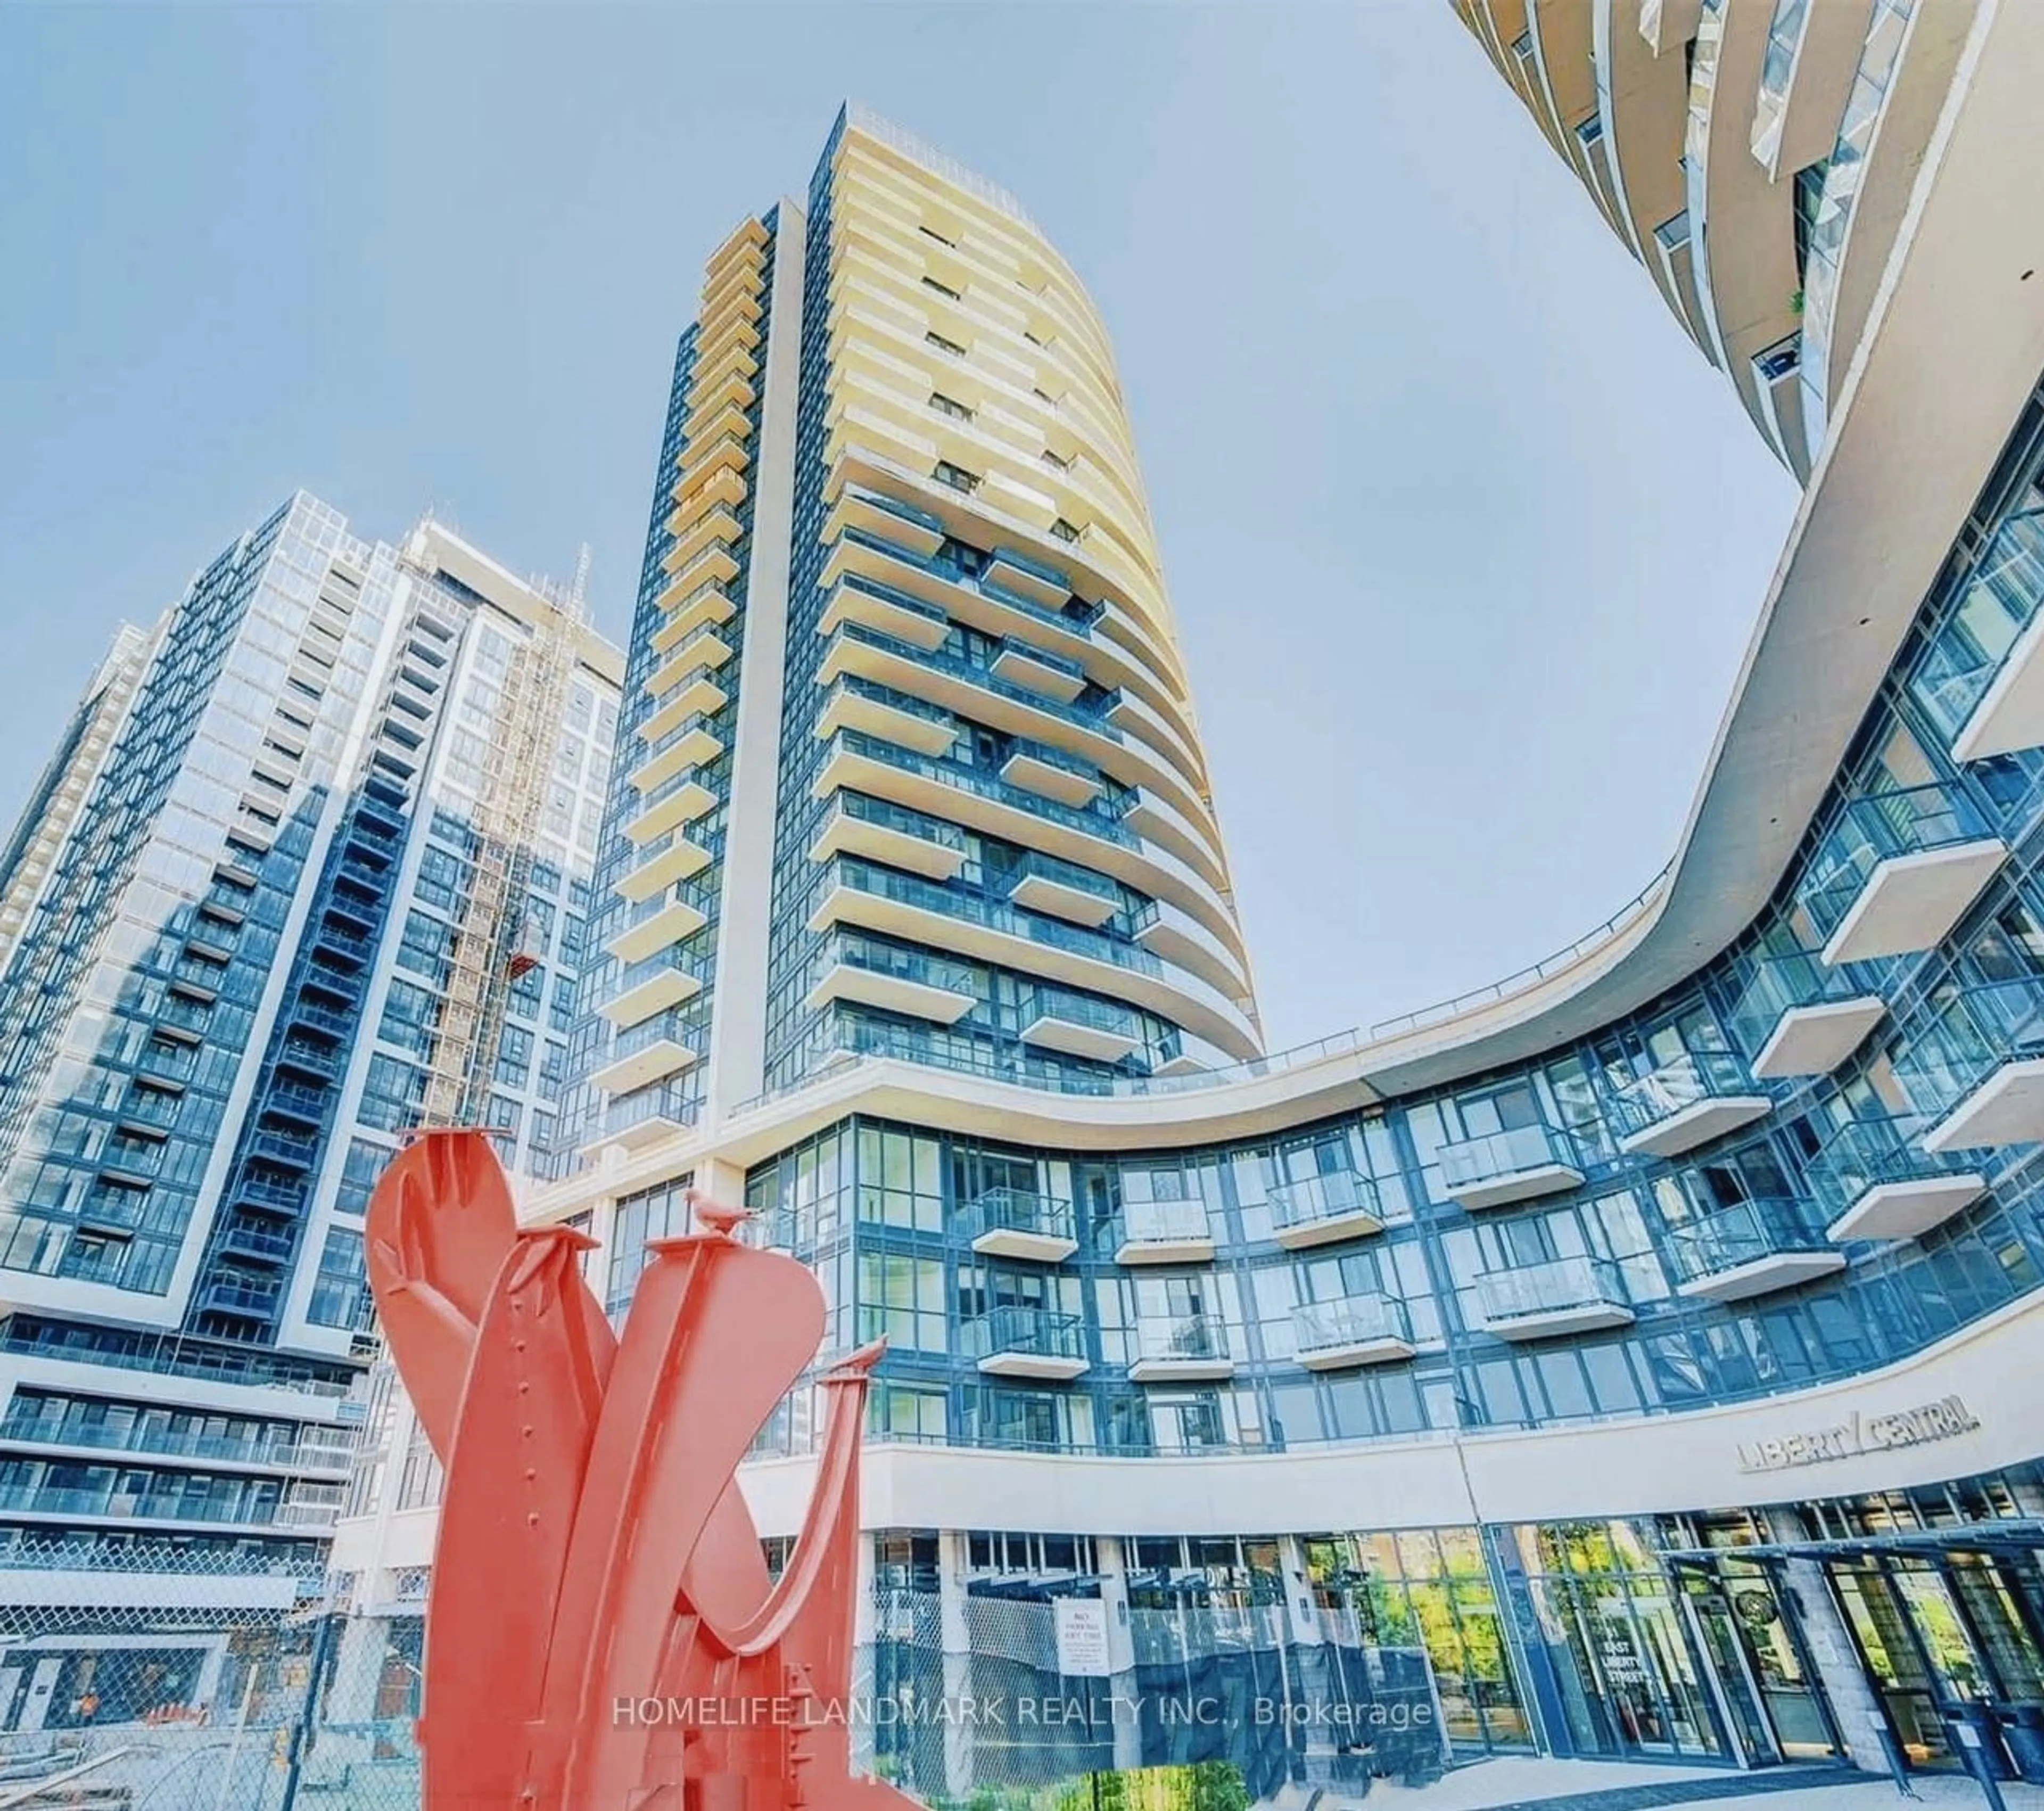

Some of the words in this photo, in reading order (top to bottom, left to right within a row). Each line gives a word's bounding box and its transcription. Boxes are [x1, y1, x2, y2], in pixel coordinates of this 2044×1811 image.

[1736, 1411, 1865, 1473] LIBERTY
[1869, 1394, 1980, 1450] CENTRAL
[1600, 1656, 1642, 1668] LIBERTY
